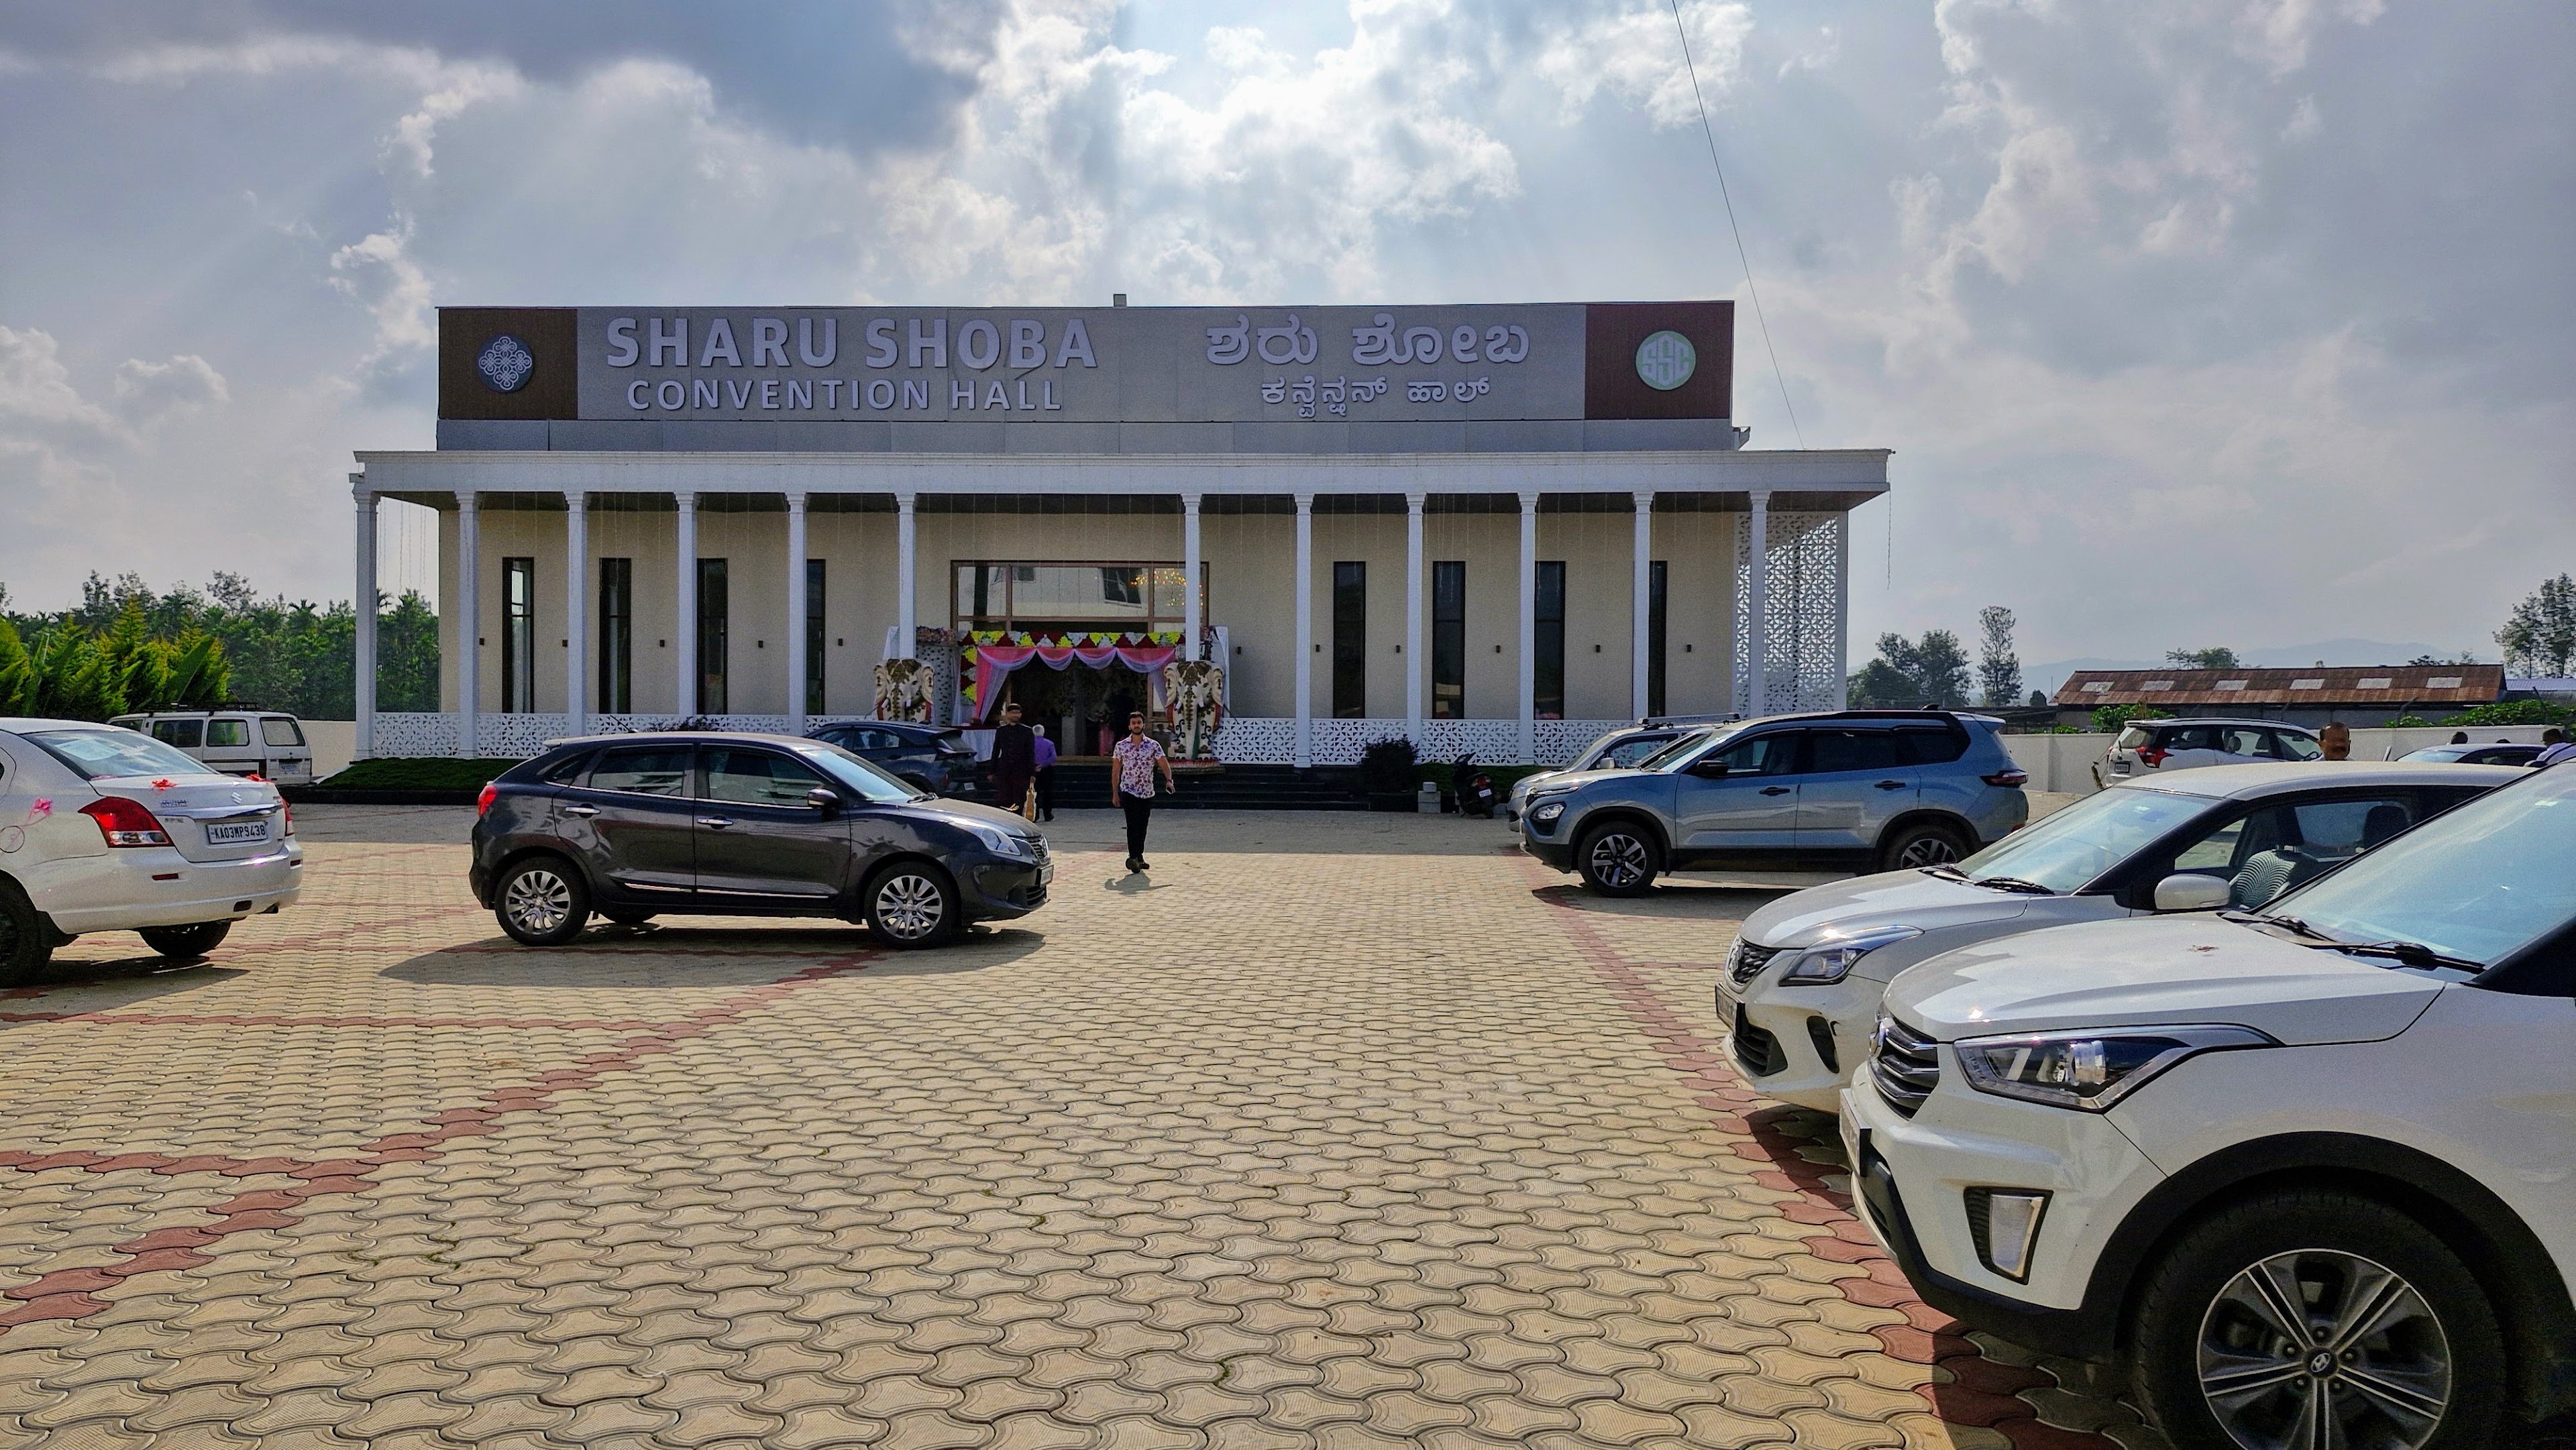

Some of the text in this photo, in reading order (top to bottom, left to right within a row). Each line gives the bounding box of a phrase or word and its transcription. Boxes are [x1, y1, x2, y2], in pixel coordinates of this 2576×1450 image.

[607, 318, 1097, 369] SHARU SHOBA
[1207, 313, 1530, 366] ಶರು ಶೋಬ
[627, 380, 1062, 410] CONVENTION HALL
[1261, 376, 1491, 419] ಕನ್ವೆನ್ಷನ್ ಹಾಲ್
[214, 824, 266, 839] KA03MP9438
